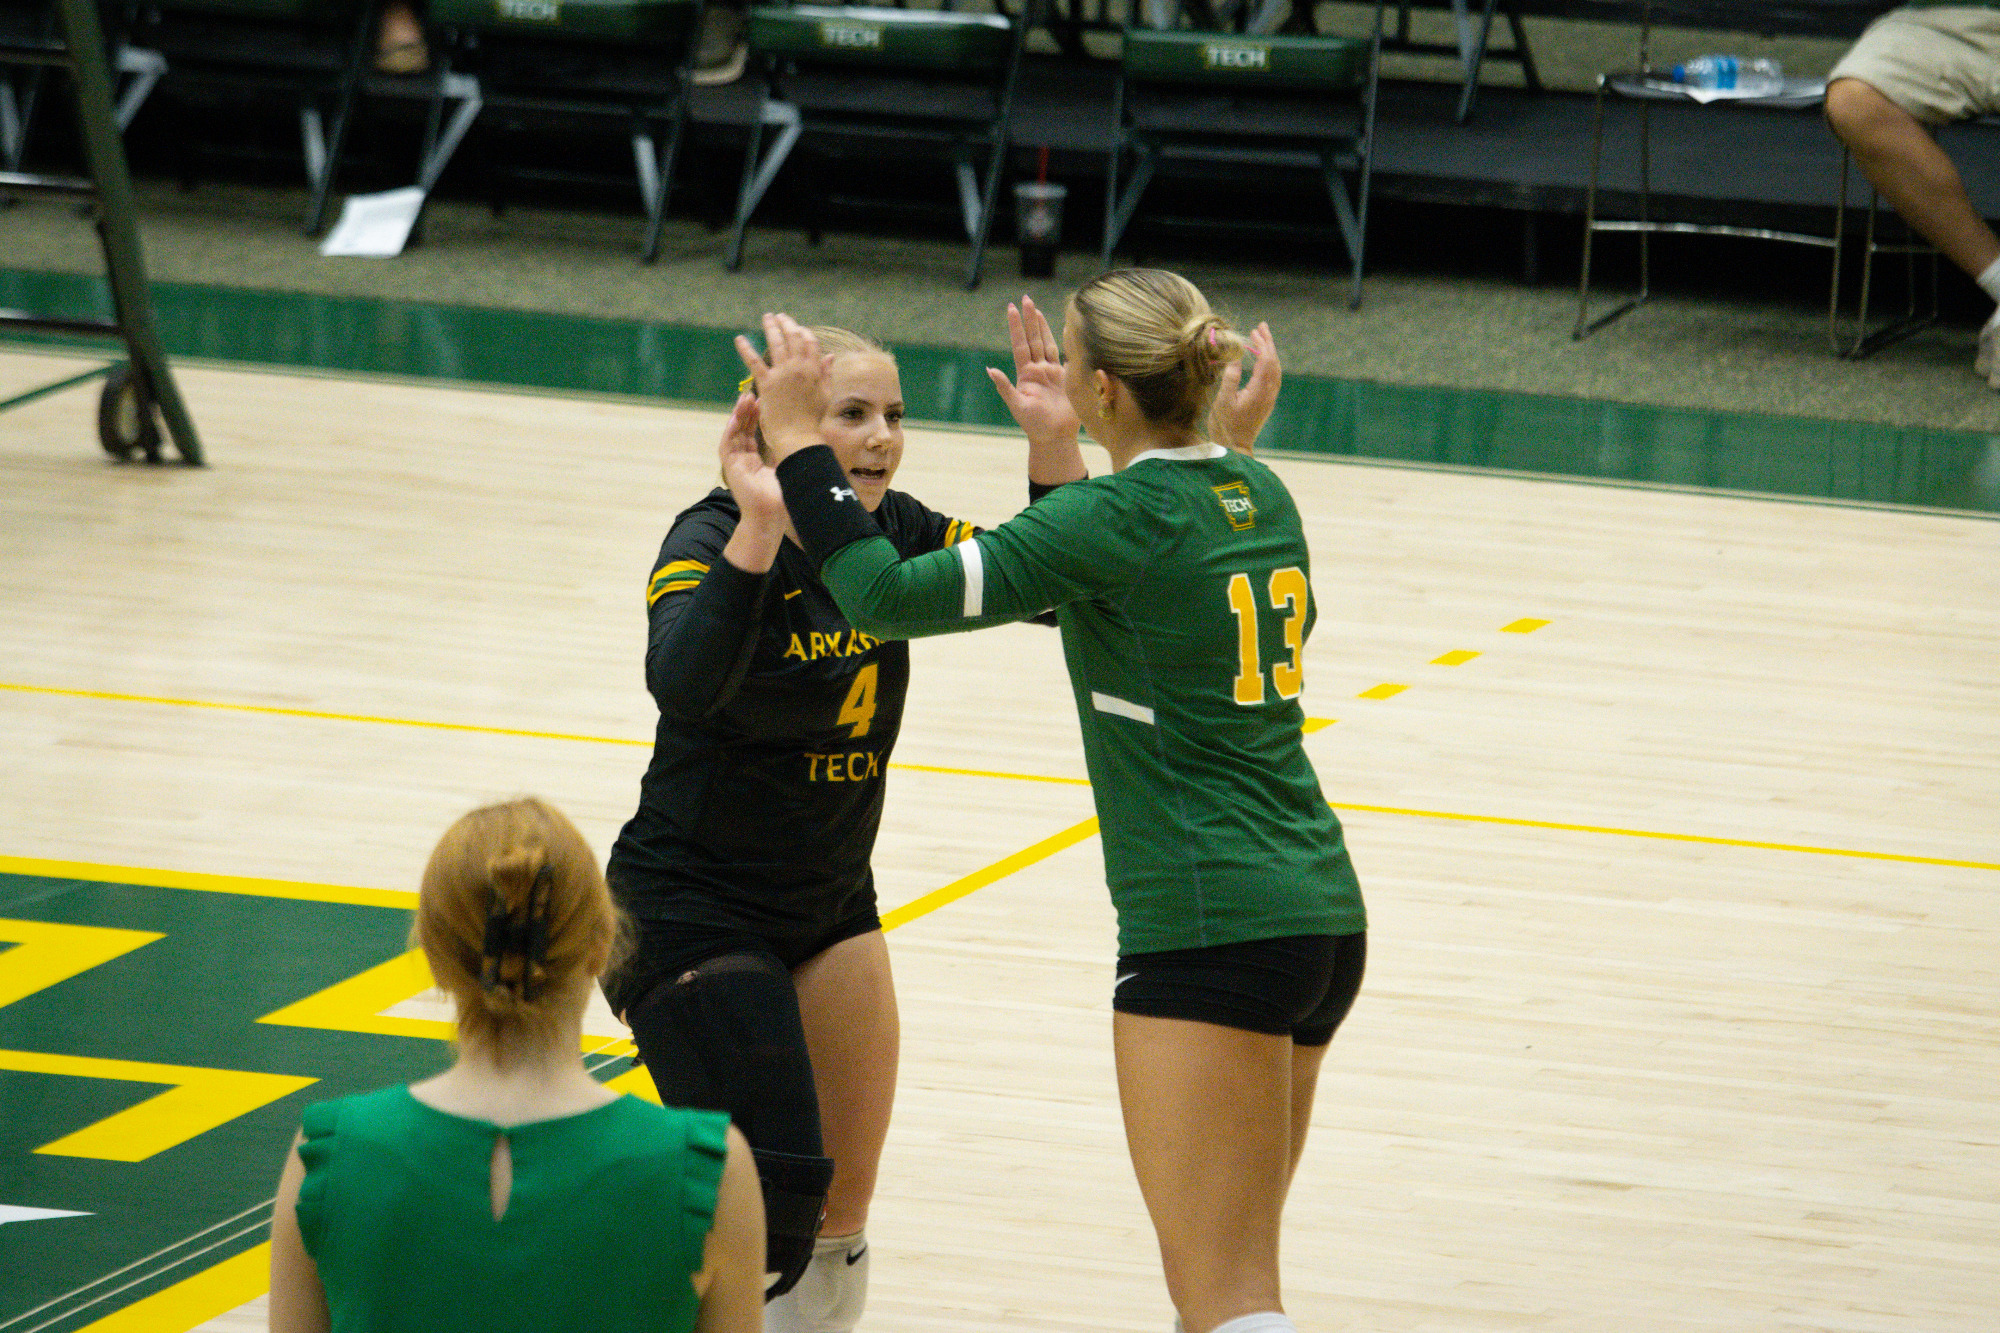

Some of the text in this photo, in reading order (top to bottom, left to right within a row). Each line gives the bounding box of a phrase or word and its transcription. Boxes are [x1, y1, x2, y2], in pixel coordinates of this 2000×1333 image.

[823, 28, 879, 46] TECH
[1208, 47, 1265, 67] TECH
[1221, 497, 1253, 512] TECH
[1227, 566, 1307, 705] 13
[836, 663, 878, 738] 4
[803, 751, 883, 781] TECH
